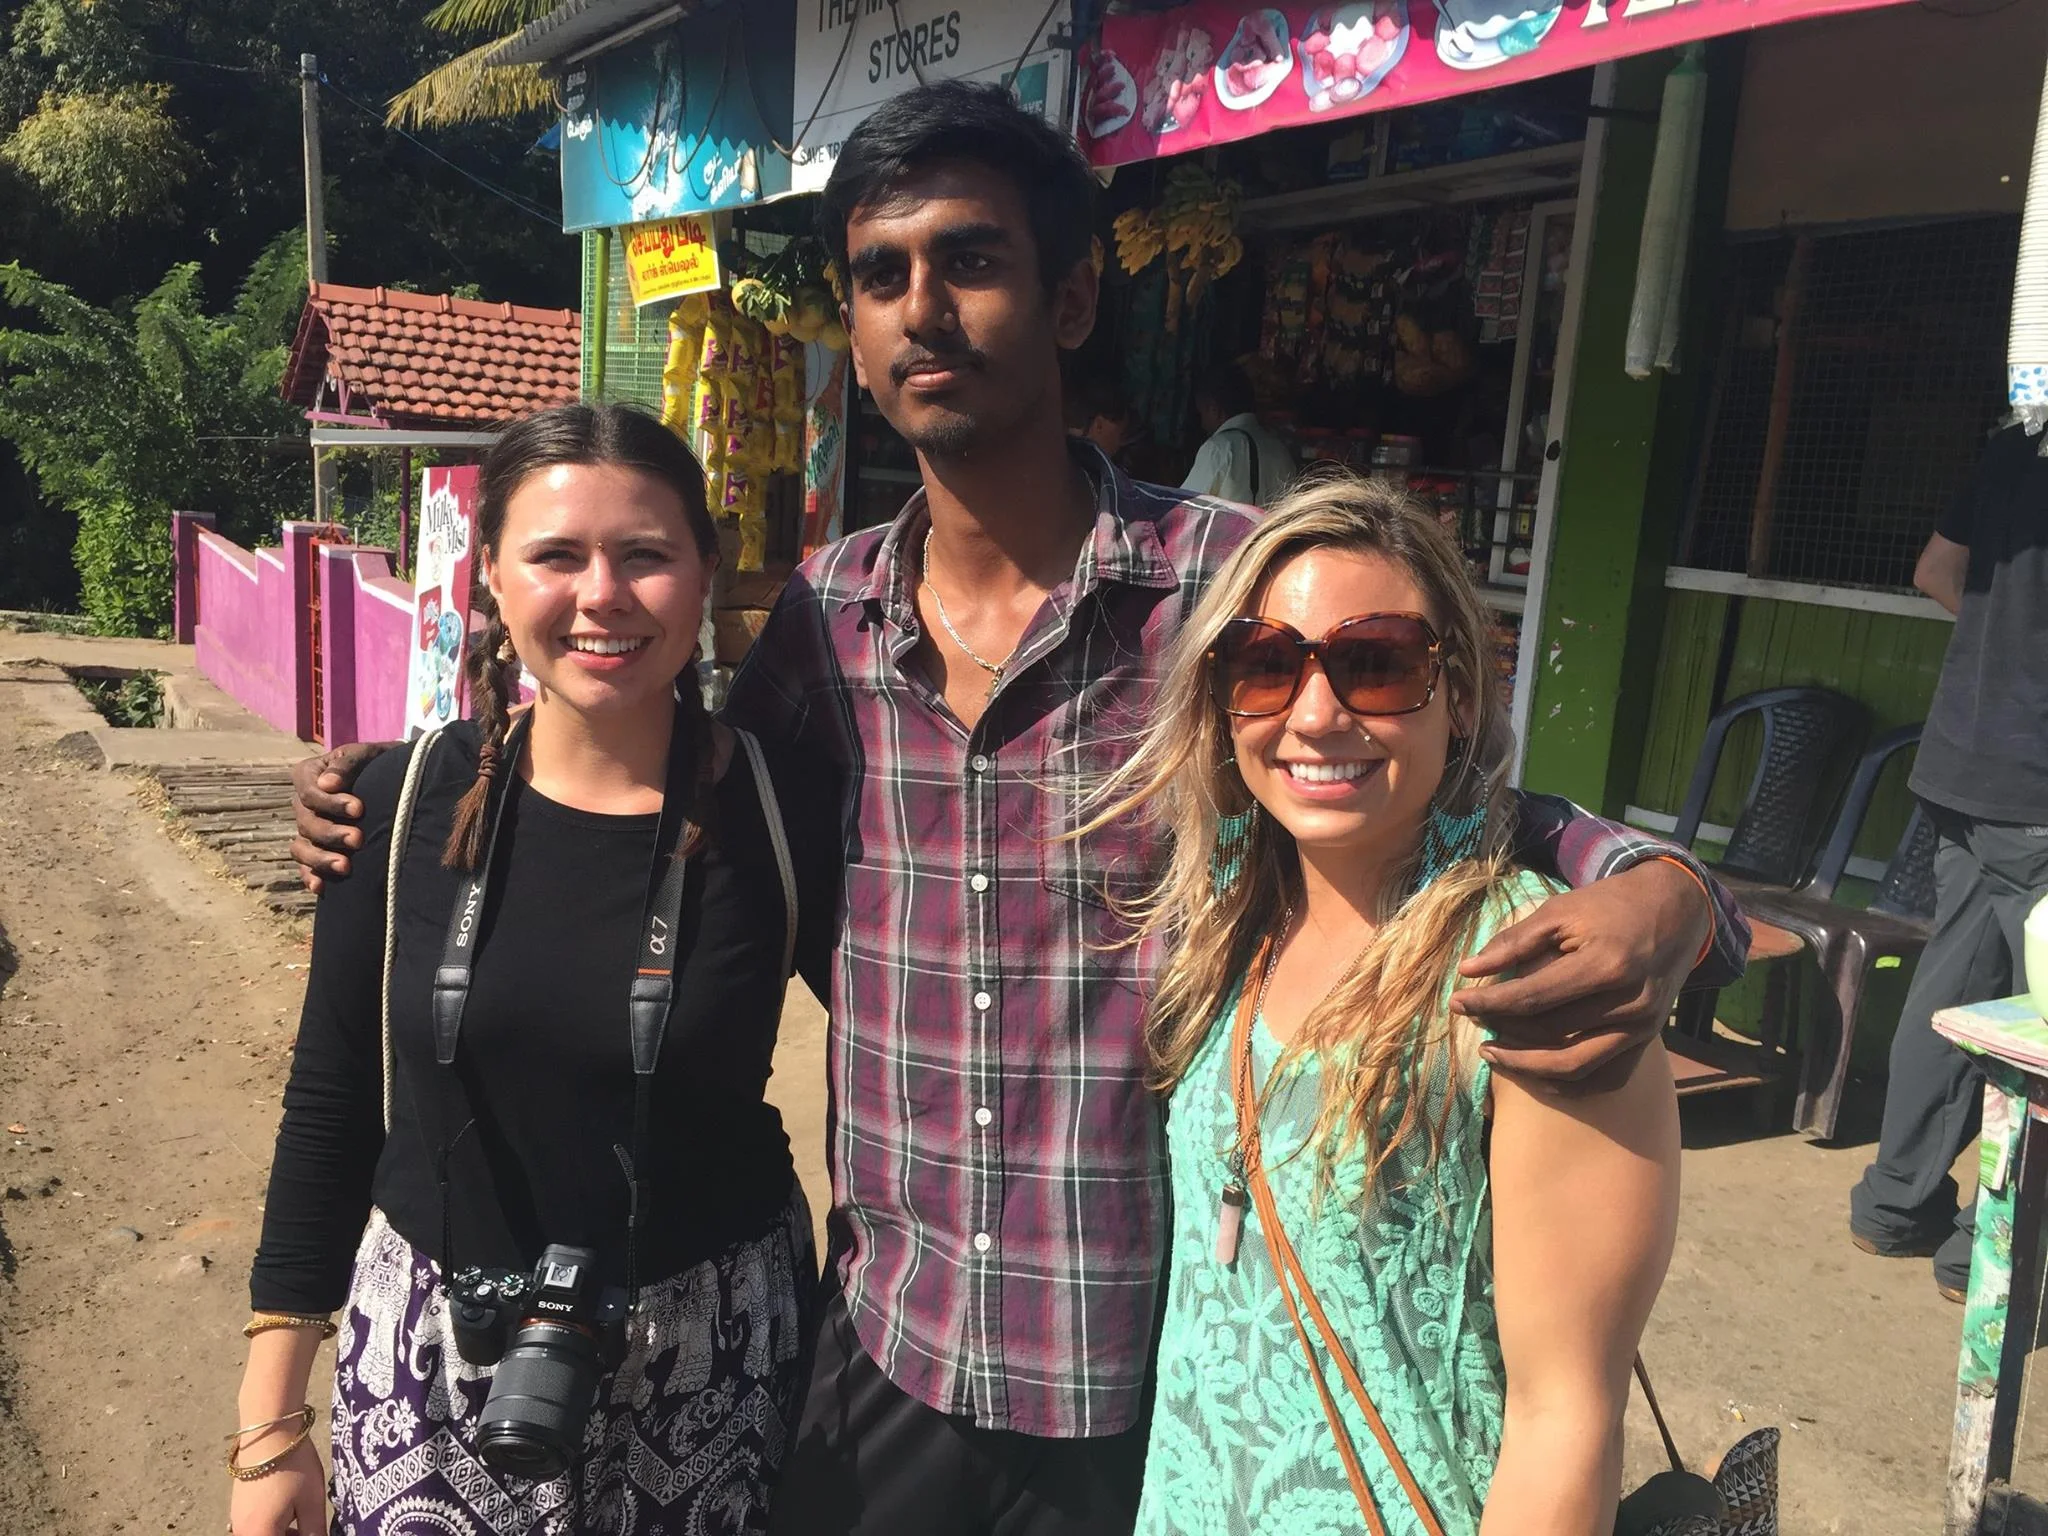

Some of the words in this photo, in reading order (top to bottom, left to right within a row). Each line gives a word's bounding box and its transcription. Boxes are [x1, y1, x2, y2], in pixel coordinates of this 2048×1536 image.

[868, 10, 960, 84] STORES
[426, 494, 457, 535] Milky
[456, 883, 481, 947] SONY
[538, 1300, 573, 1312] SONY
